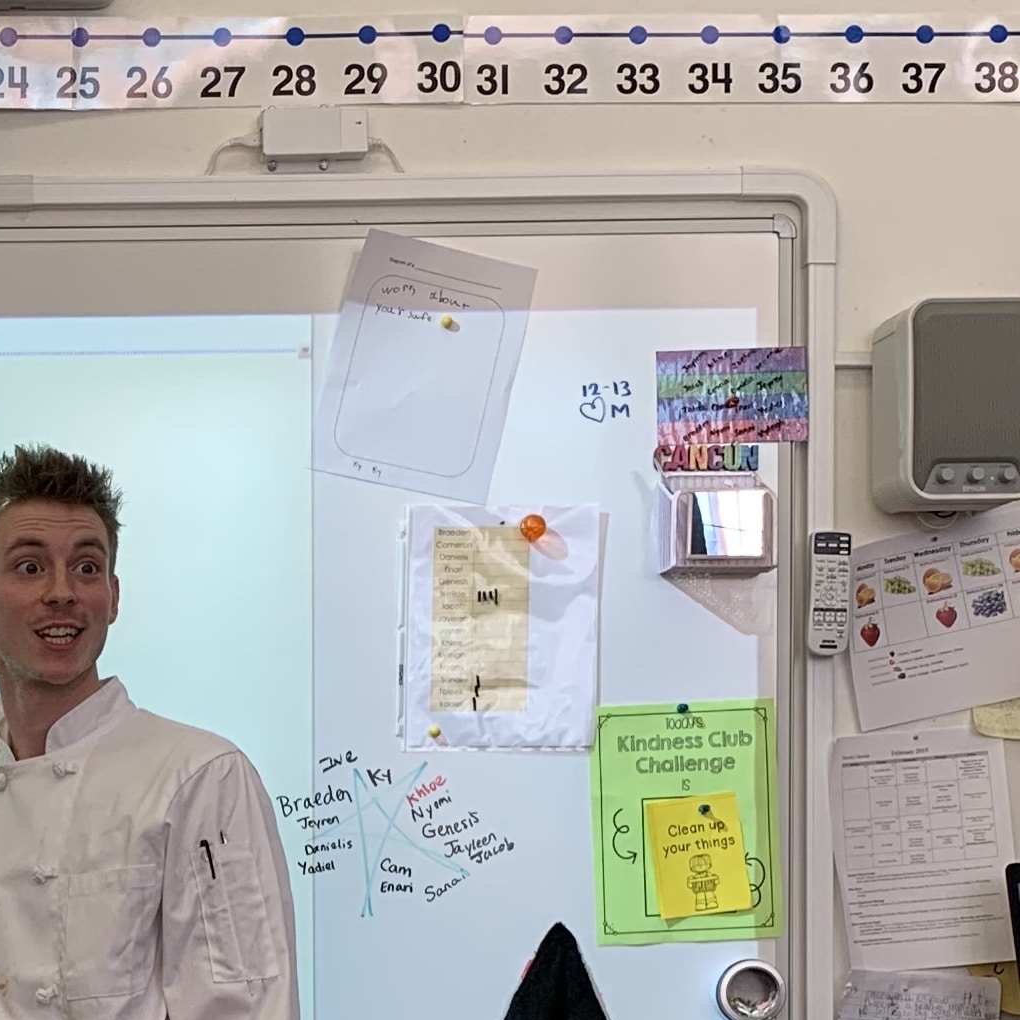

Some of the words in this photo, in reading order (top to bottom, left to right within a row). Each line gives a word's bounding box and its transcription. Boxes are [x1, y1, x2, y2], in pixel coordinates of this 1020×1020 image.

[57, 67, 100, 99] 25
[127, 67, 172, 98] 26
[200, 66, 245, 98] 27
[273, 65, 316, 96] 28
[344, 63, 387, 95] 29
[417, 61, 461, 93] 30
[477, 64, 508, 95] 31
[544, 64, 587, 95] 32
[617, 63, 660, 94] 33
[688, 63, 732, 94] 34
[758, 62, 801, 94] 35
[830, 62, 874, 93] 36
[902, 63, 946, 94] 37
[975, 62, 1019, 93] 38
[617, 733, 704, 753] Kindness
[708, 730, 753, 748] Club
[635, 755, 736, 775] Challenge
[277, 785, 353, 817] Braeden
[411, 790, 452, 822] Nyomi
[422, 811, 480, 839] Genesis
[667, 821, 705, 838] Clean
[709, 821, 726, 833] up
[304, 838, 353, 856] Danielis
[443, 832, 497, 858] Jayleen
[469, 837, 515, 864] Jacob
[663, 841, 691, 859] your
[695, 837, 736, 851] things
[297, 860, 335, 876] Yadiel
[380, 858, 412, 877] Cam
[380, 881, 414, 893] Enari
[424, 874, 467, 903] Sanai
